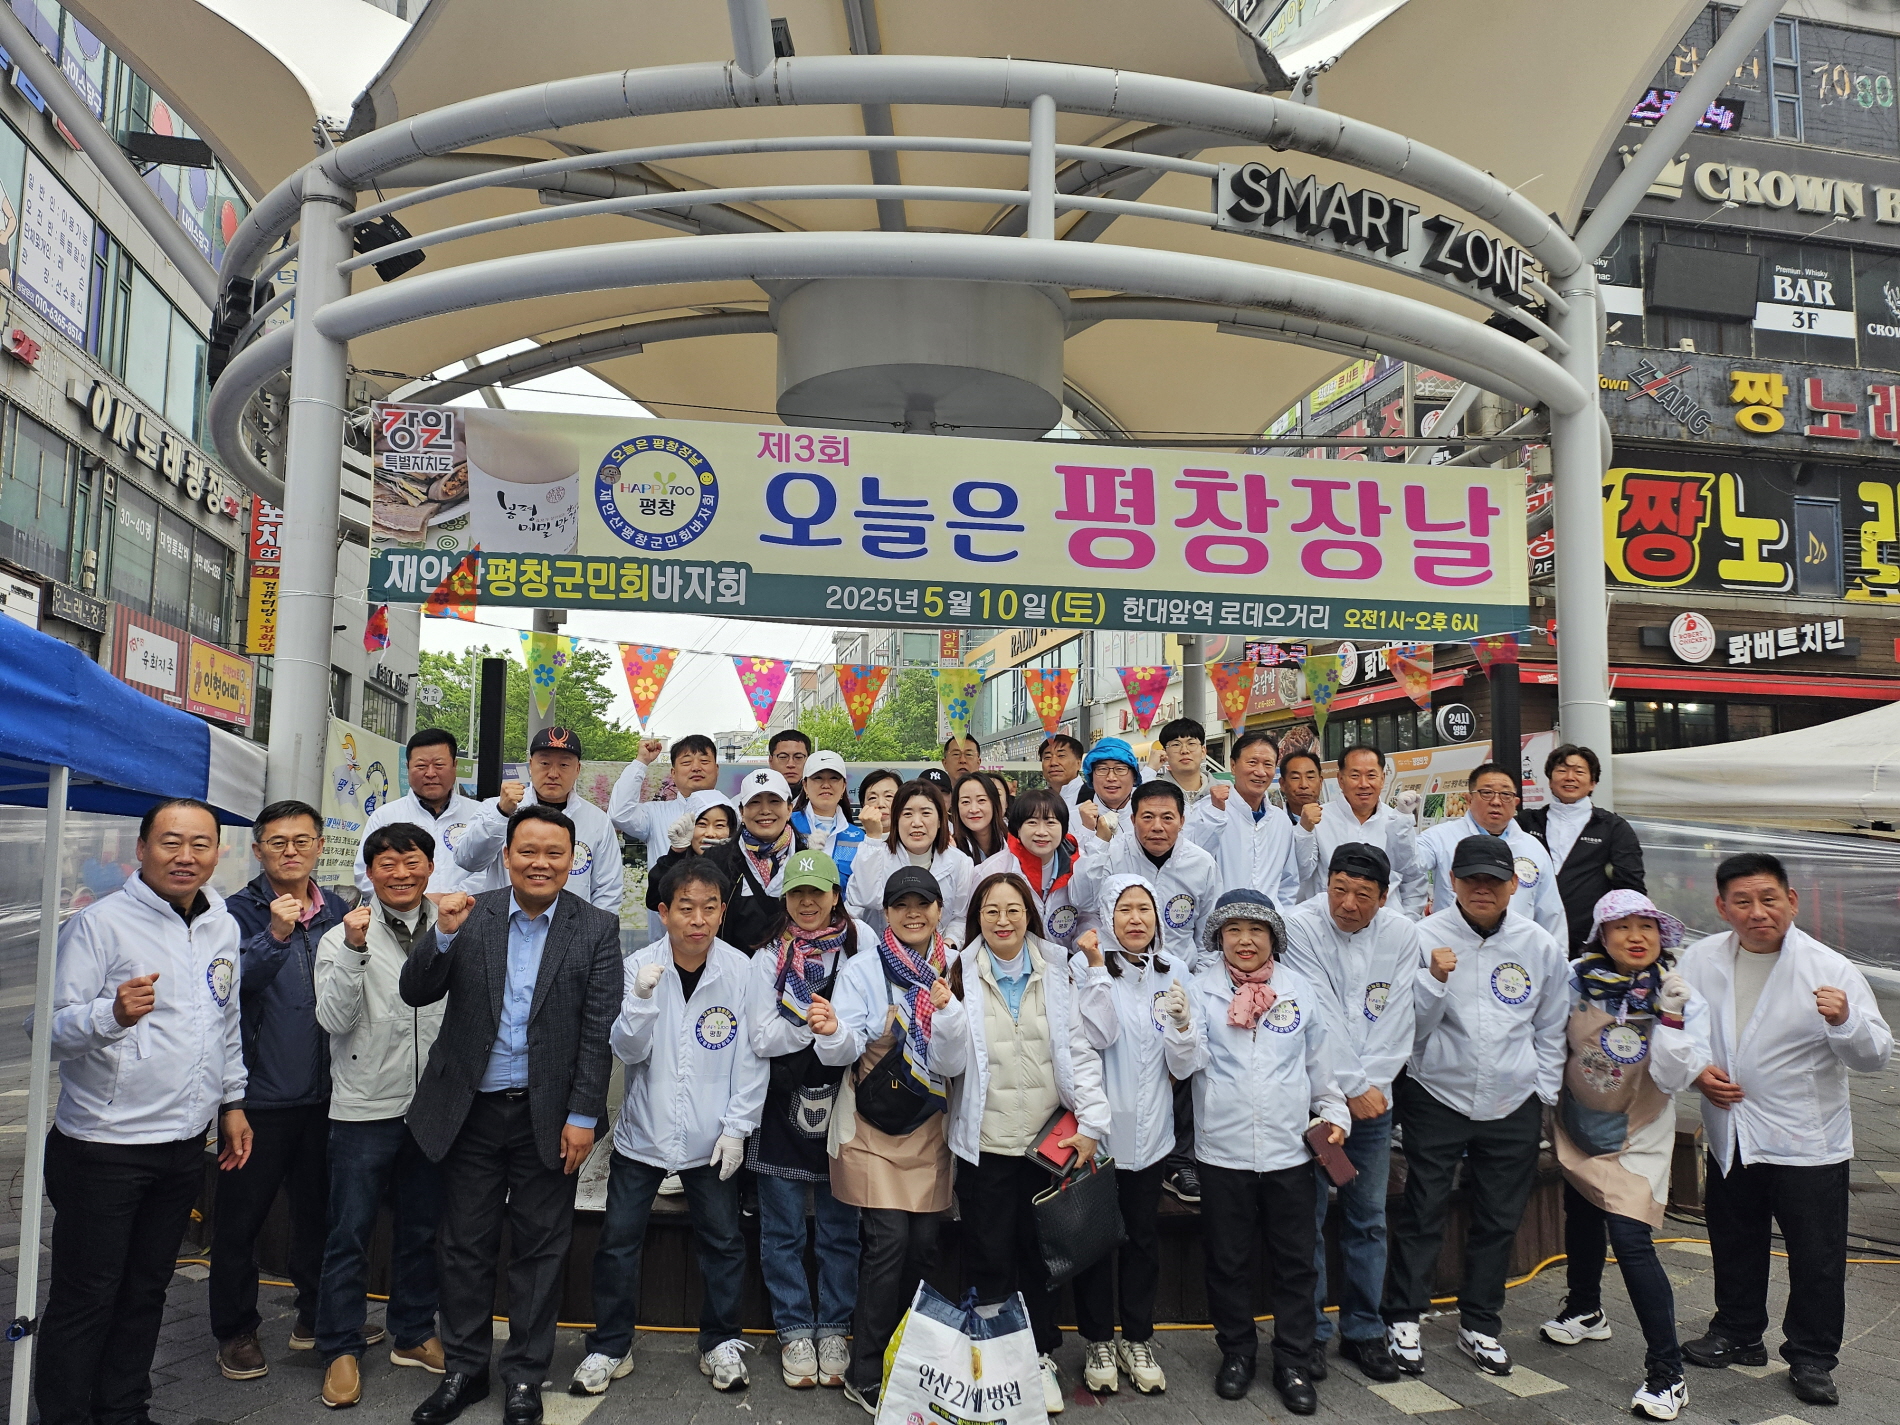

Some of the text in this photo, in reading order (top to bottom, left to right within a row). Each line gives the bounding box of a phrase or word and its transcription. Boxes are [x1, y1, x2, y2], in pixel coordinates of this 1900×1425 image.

[1694, 162, 1865, 219] CROWN
[1228, 161, 1535, 307] SMART ZONE
[1804, 267, 1829, 279] Whisky
[1773, 275, 1836, 306] BAR
[1791, 310, 1820, 330] 3F
[383, 409, 454, 452] 강원
[384, 454, 452, 472] 특별자치도
[611, 438, 703, 467] 오늘은 평창장날
[756, 430, 851, 467] 제3회
[620, 472, 695, 496] HAPPY 700
[599, 488, 715, 549] 재안산평창군민회바자회
[639, 498, 676, 517] 평창
[758, 471, 1026, 563] 오늘은
[1054, 464, 1500, 588] 평창장날
[259, 549, 279, 558] 2F
[260, 580, 278, 617] 컴퓨터방
[825, 586, 918, 614] 2025년
[923, 587, 972, 618] 5월
[1122, 595, 1331, 631] 한대앞역 로데오거리
[1011, 629, 1038, 658] RADIO
[141, 650, 175, 677] 육회지존
[1448, 712, 1470, 726] 24시
[1453, 725, 1467, 737] 영업
[798, 857, 815, 872] NY
